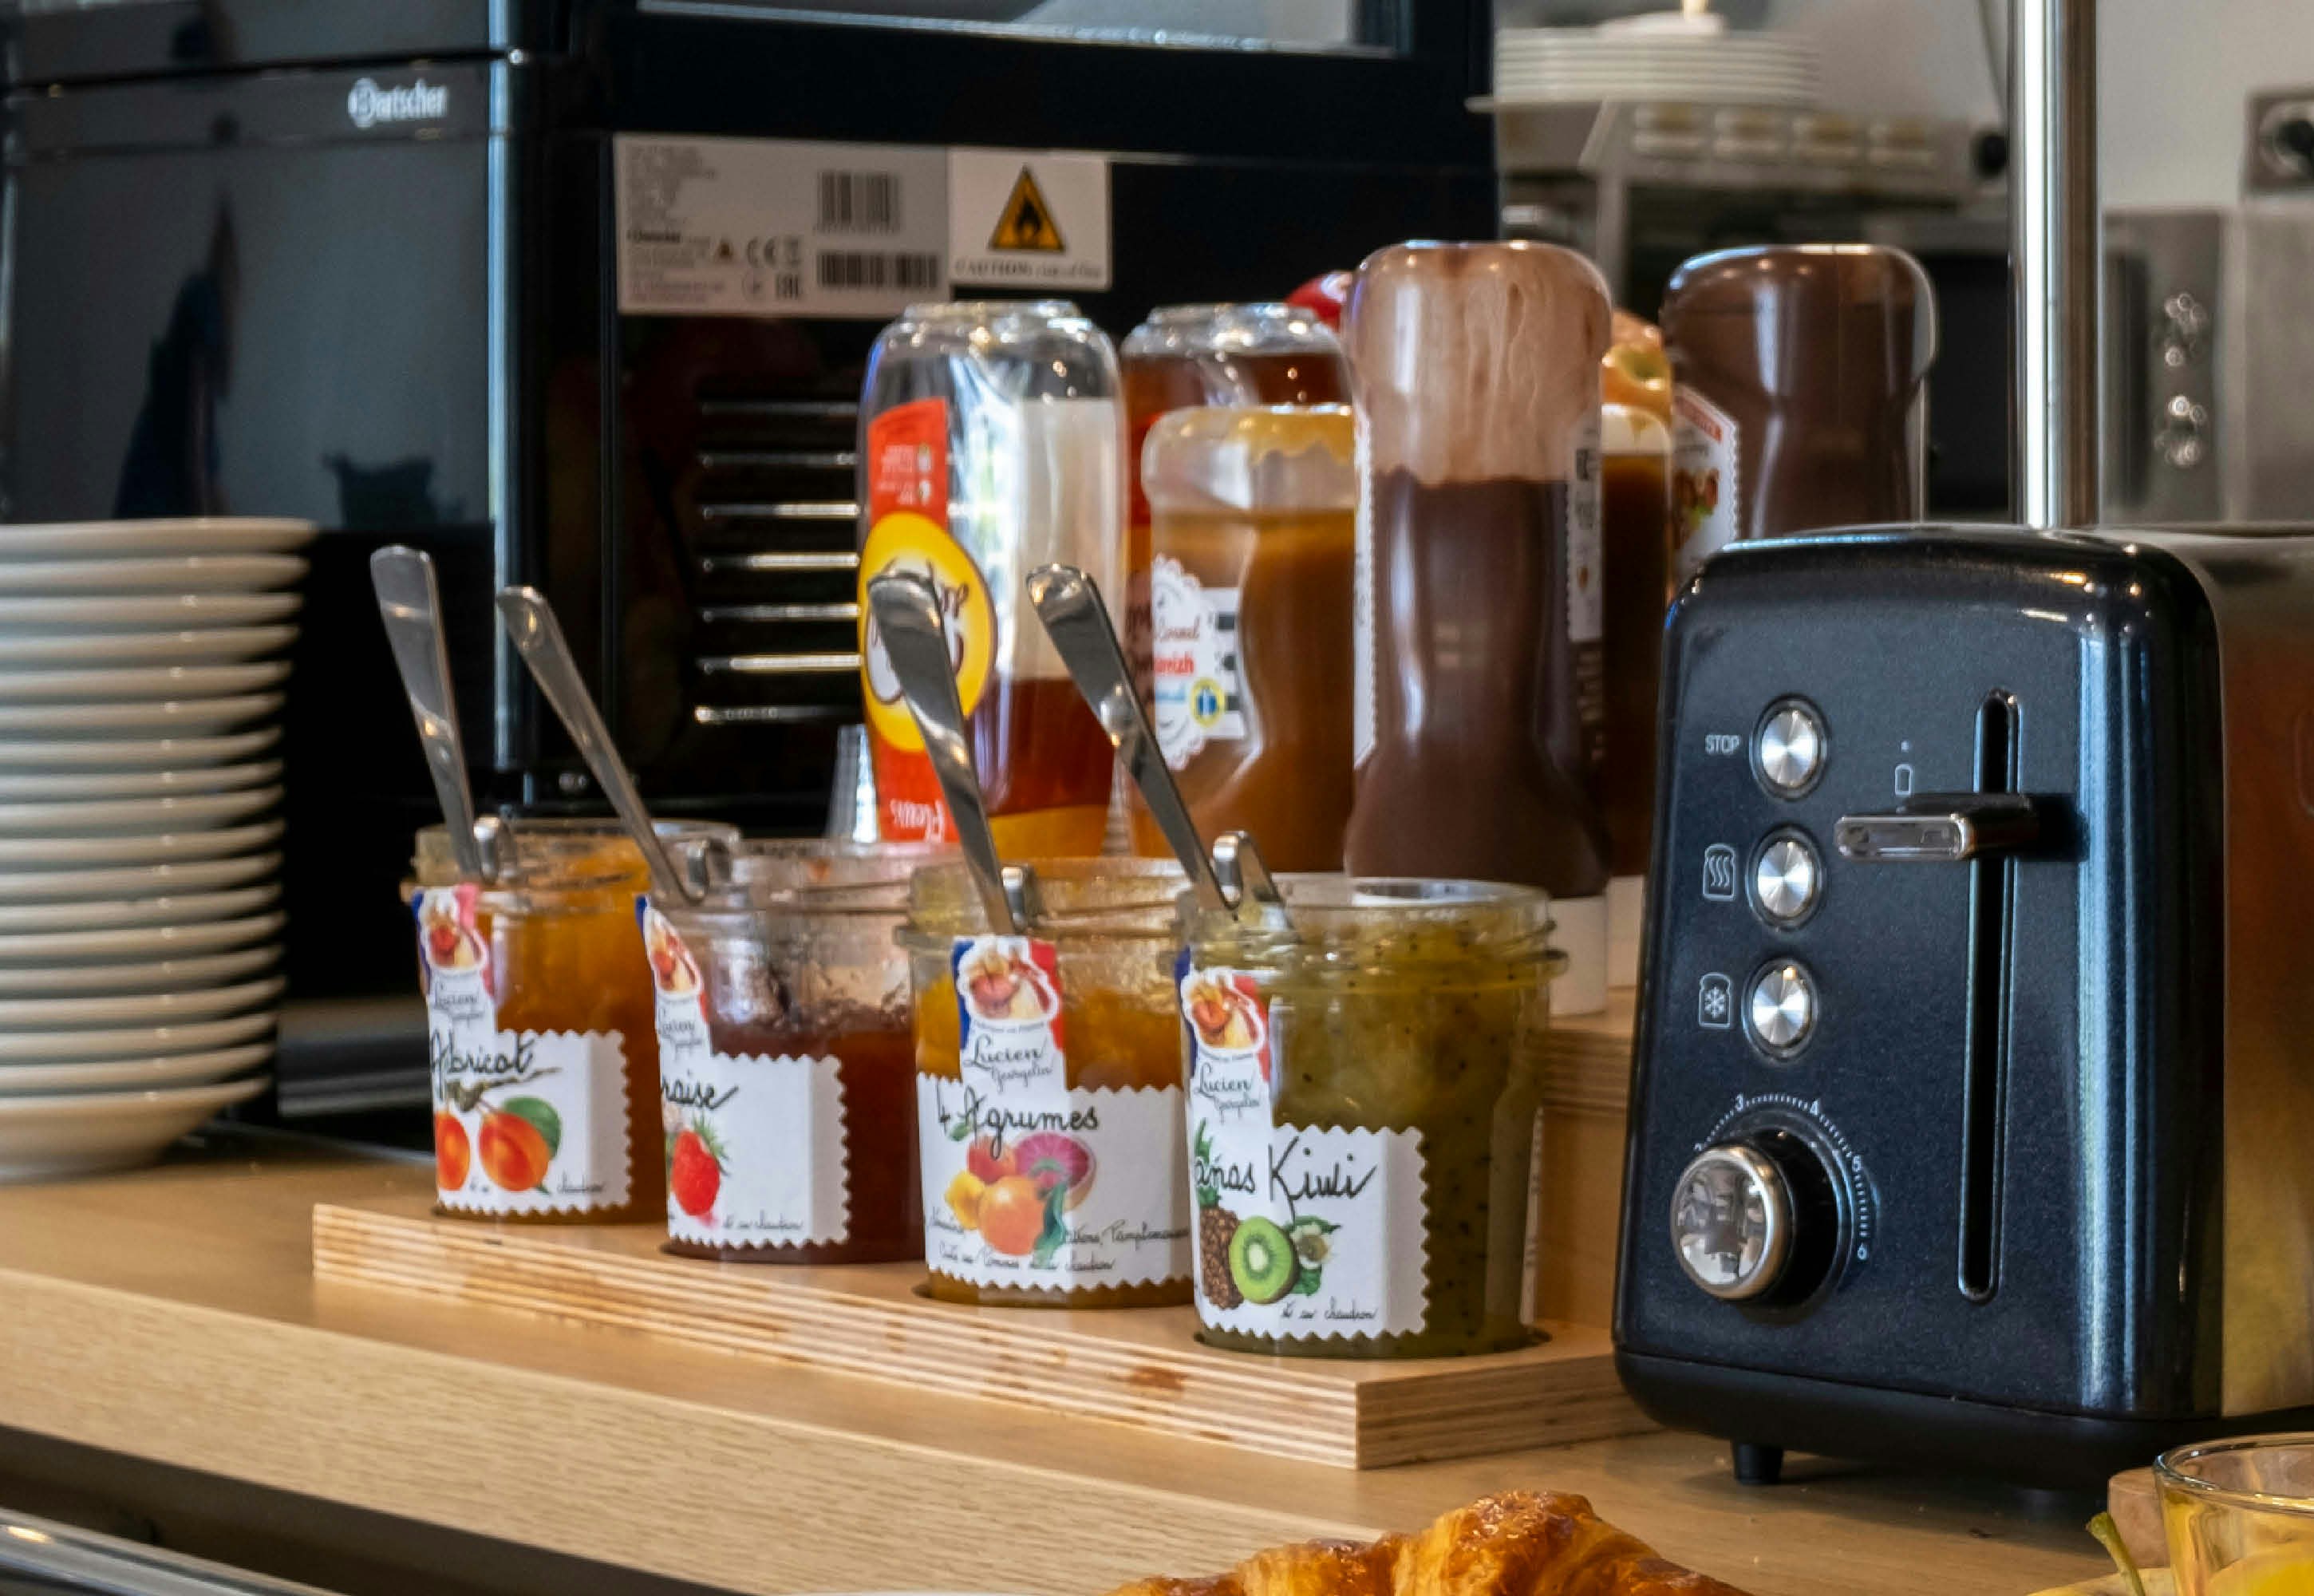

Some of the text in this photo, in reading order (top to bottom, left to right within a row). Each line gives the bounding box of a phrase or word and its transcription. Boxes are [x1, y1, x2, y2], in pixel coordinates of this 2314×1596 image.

[1705, 734, 1740, 754] STOP
[431, 1027, 535, 1093] Abricot
[962, 1034, 1048, 1071] Lucien
[661, 1070, 740, 1110] raise
[1195, 1062, 1256, 1100] Lucien
[1735, 1093, 1744, 1112] 3
[1809, 1099, 1821, 1116] 4
[958, 1084, 1100, 1160] Agrumes
[1268, 1136, 1379, 1223] Kiwi
[1852, 1155, 1862, 1173] 5
[1856, 1242, 1869, 1261] 6
